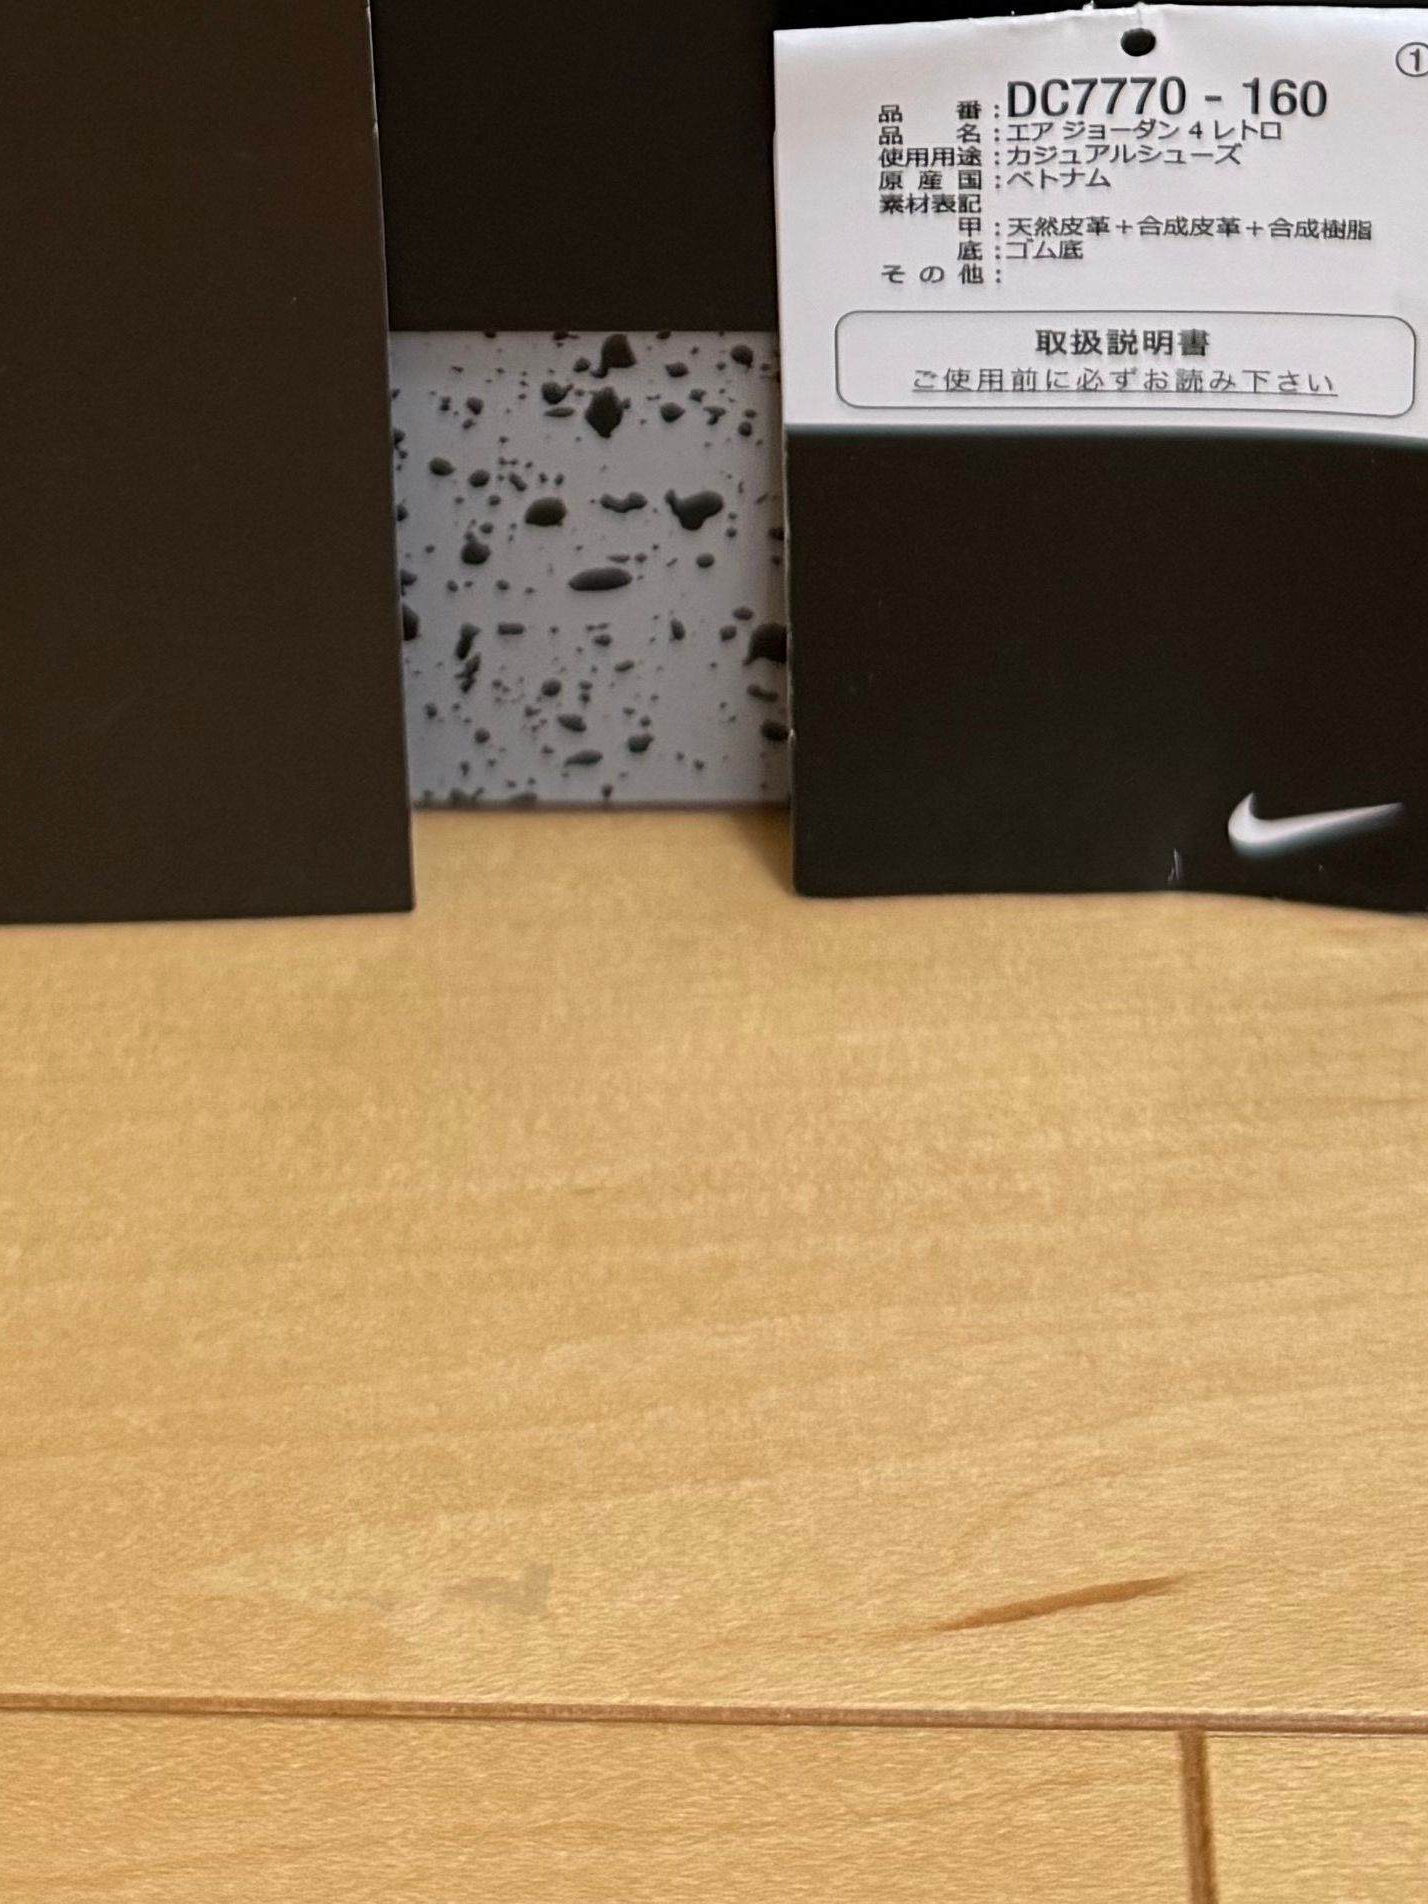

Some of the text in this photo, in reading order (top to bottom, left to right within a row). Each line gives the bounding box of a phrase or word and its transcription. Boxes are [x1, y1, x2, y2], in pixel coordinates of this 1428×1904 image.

[1006, 76, 1187, 120] DC7770
[1242, 77, 1328, 119] 160
[1006, 143, 1243, 167] カジュアルシューズ
[1006, 167, 1112, 190] ベトナム
[878, 193, 983, 215] 素材表記
[1006, 239, 1085, 261] ゴム底
[1035, 328, 1210, 357] 取扱説明書
[912, 367, 1335, 395] ご使用前に必ずお読み下さい
